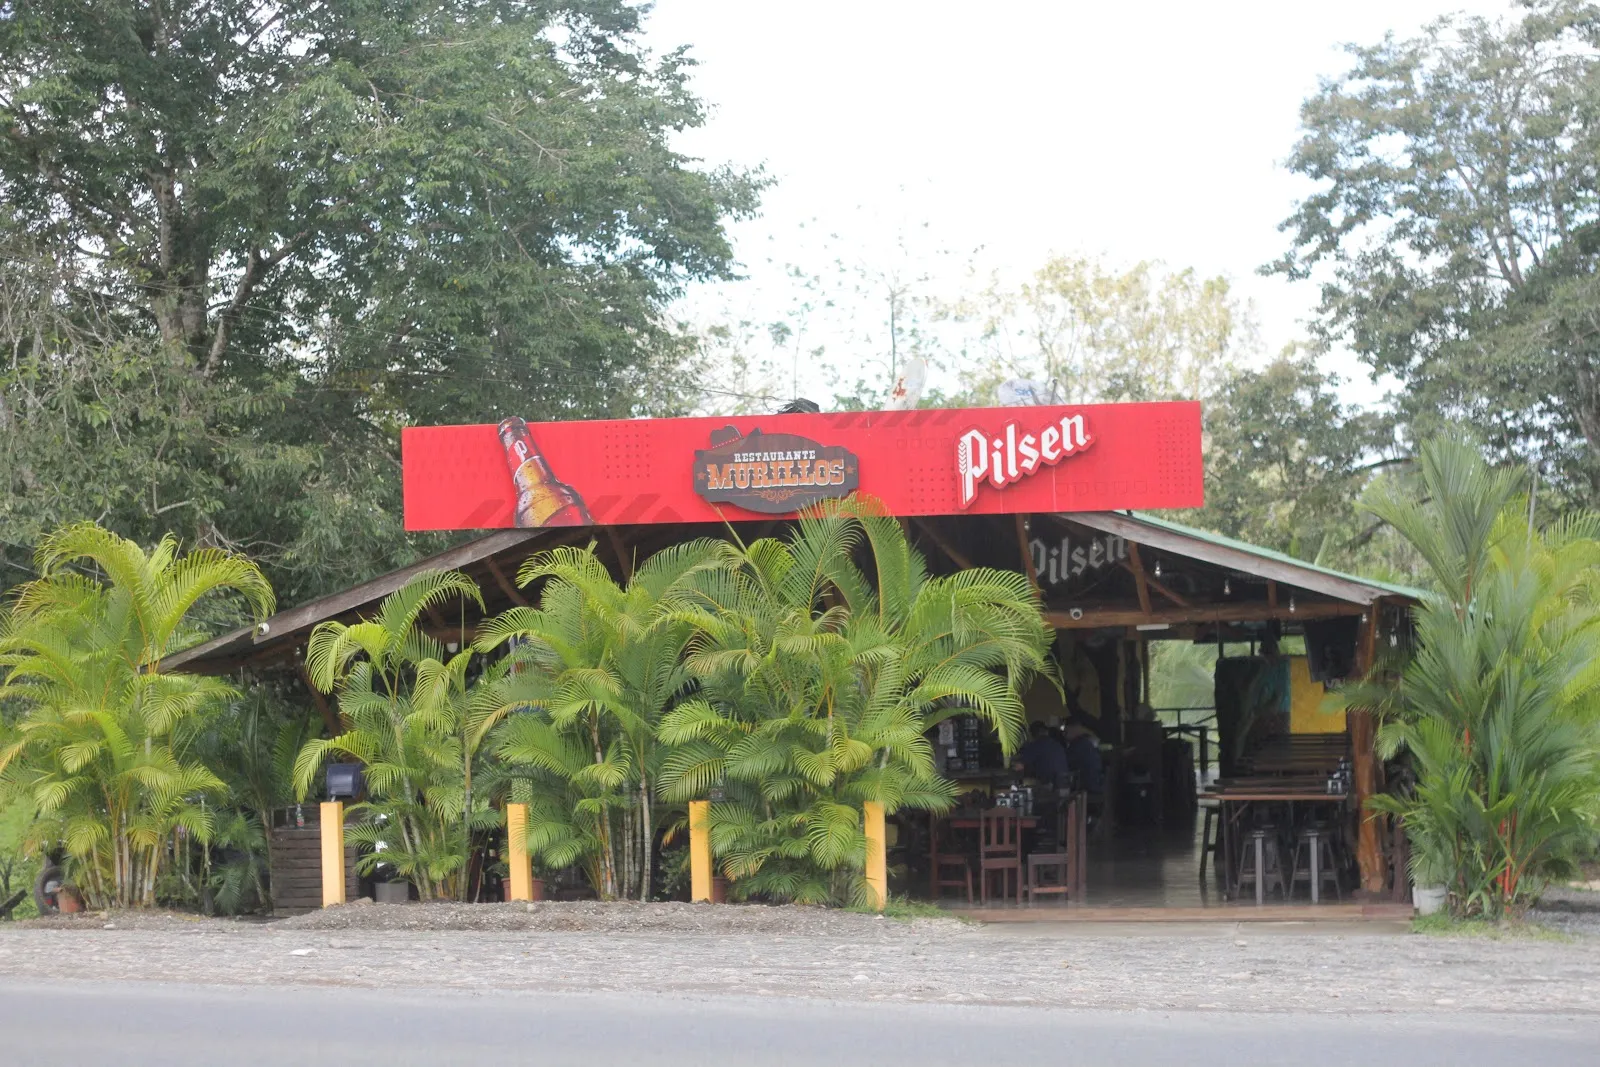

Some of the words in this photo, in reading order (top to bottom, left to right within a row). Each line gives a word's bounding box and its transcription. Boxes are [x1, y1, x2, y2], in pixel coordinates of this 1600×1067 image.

[734, 450, 816, 463] RESTAURANTE
[958, 414, 1087, 504] Pilsen
[707, 460, 844, 490] MURILLOS
